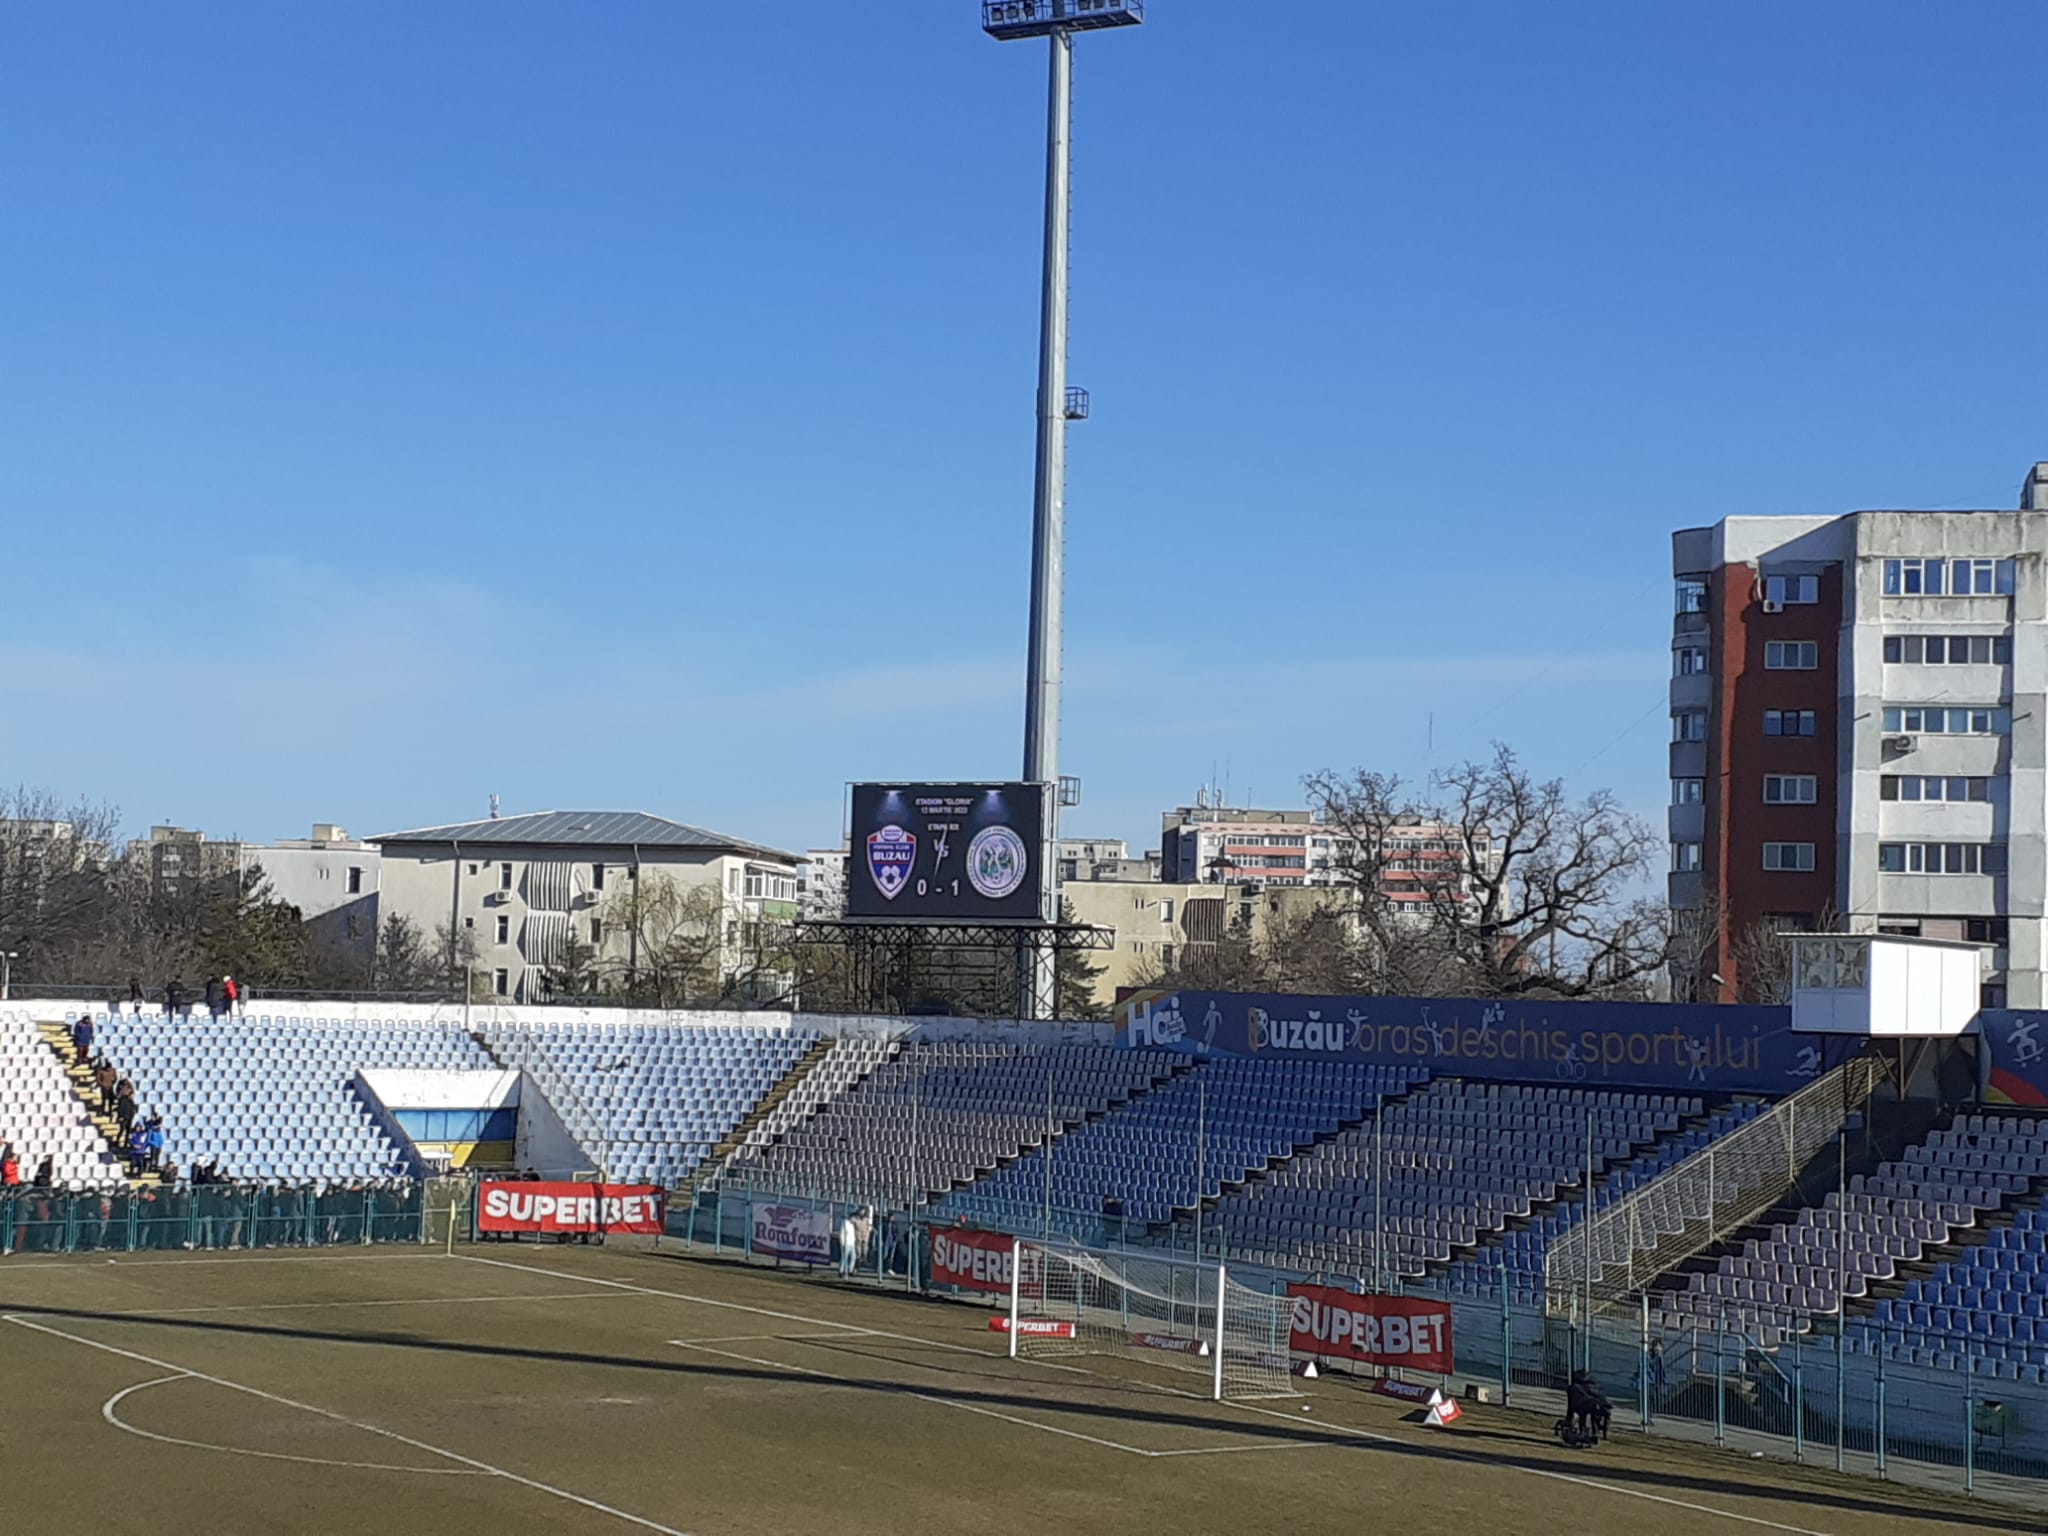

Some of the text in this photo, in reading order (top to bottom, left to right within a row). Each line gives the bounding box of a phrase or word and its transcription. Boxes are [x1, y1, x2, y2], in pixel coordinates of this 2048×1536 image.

[917, 879, 927, 896] 0
[951, 879, 959, 896] 1
[1440, 1016, 1568, 1061] deschis
[1580, 1023, 1761, 1076] sportului
[485, 1188, 662, 1224] SUPERBET
[754, 1221, 827, 1250] Romfour
[1292, 1295, 1445, 1355] SUPERBET
